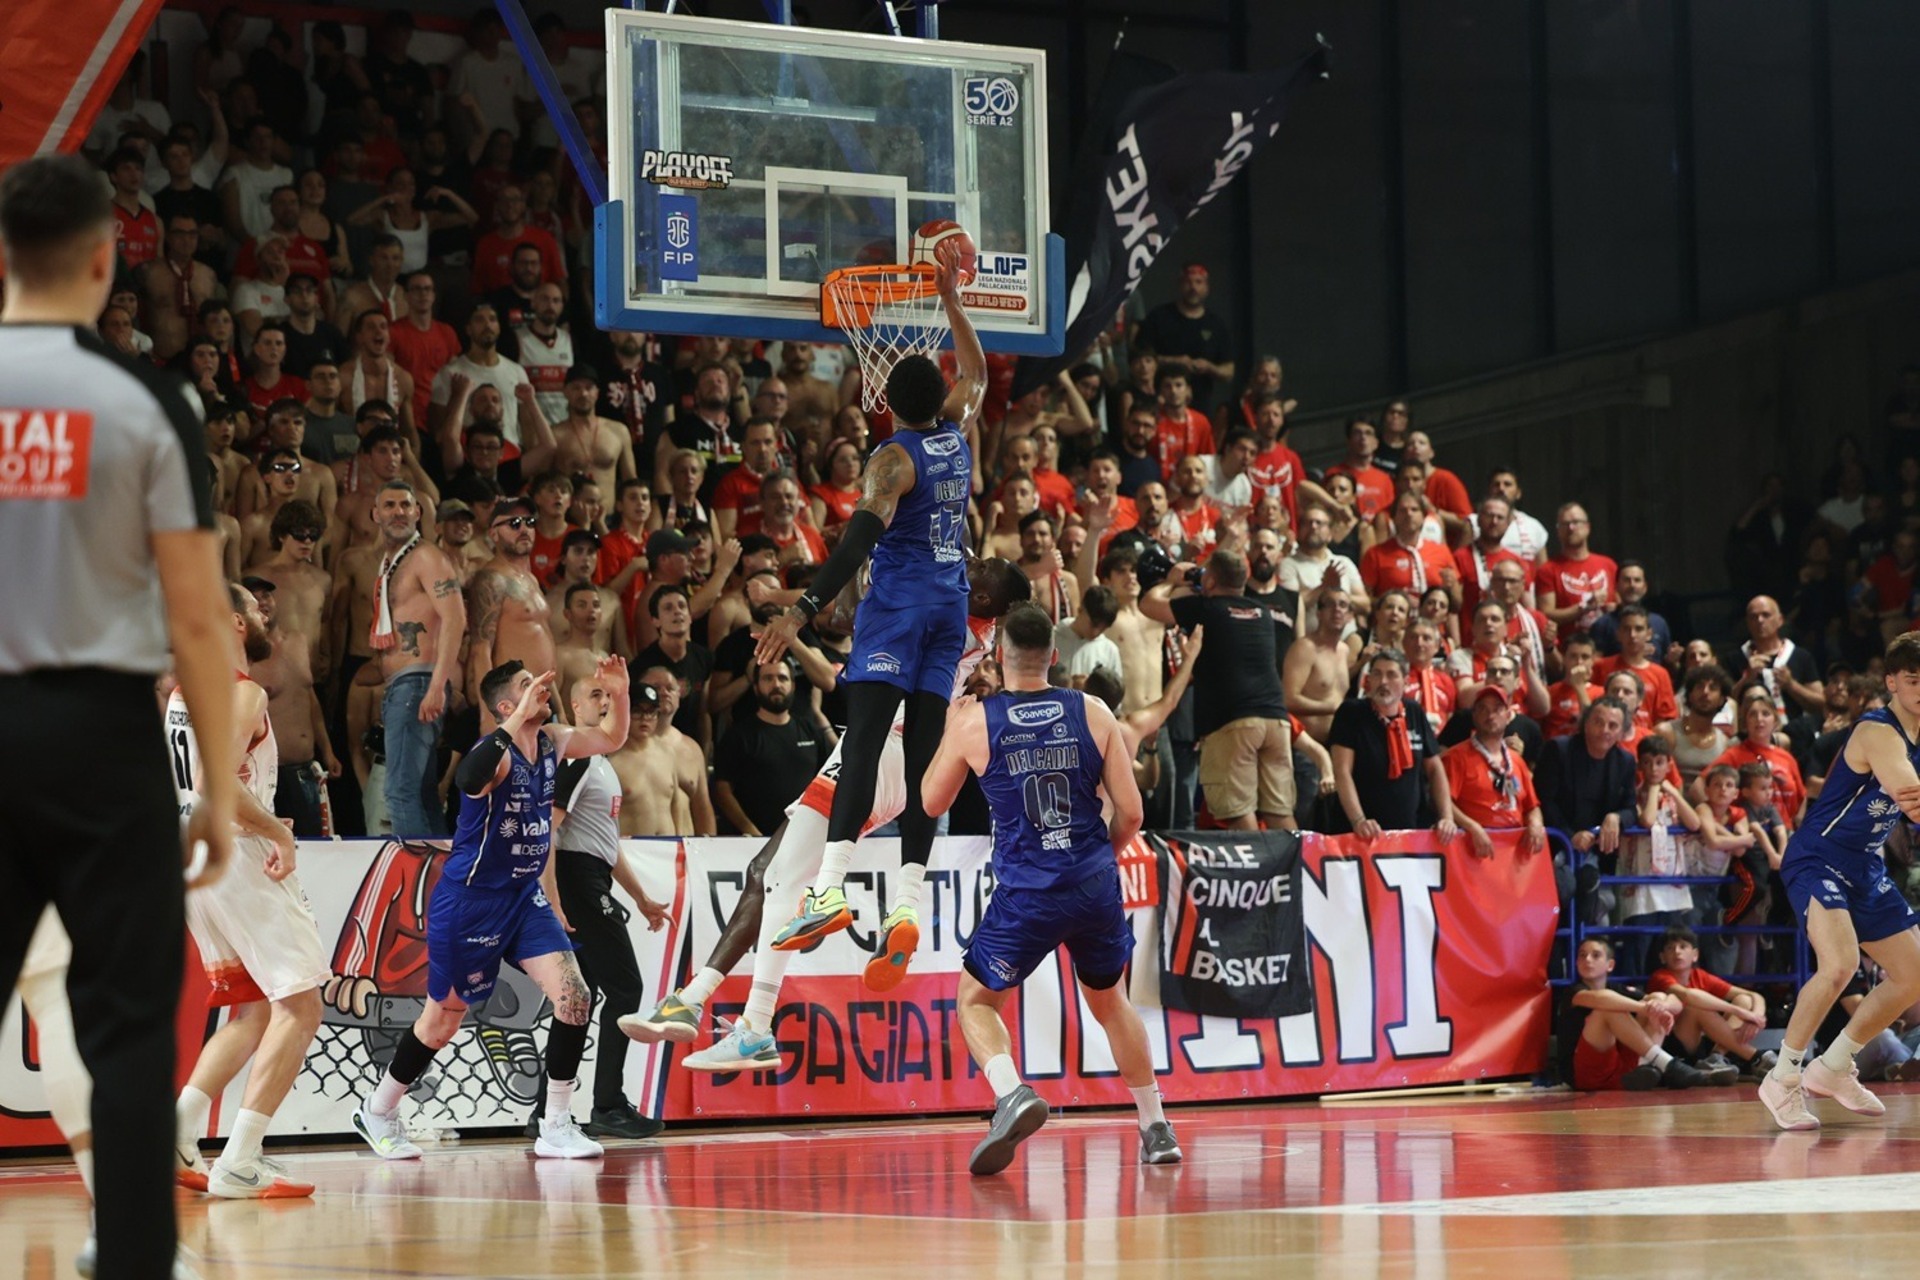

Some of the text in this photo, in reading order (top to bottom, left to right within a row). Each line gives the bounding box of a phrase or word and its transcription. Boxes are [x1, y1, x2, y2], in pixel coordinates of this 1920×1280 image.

[967, 115, 1013, 126] SERIE A2
[641, 151, 733, 184] PLAYOFF
[664, 251, 694, 265] FIP
[978, 255, 1027, 276] LNP
[978, 283, 1028, 291] PALLACANESTRO
[995, 277, 1027, 285] NAZIONALE
[977, 296, 999, 307] WILD
[999, 297, 1023, 308] WEST
[929, 501, 964, 549] 17
[1018, 705, 1060, 719] Soavegel
[1023, 772, 1072, 832] 10
[1188, 842, 1260, 869] ALLE
[1187, 874, 1291, 911] CINQUE
[1190, 950, 1291, 987] BASKET
